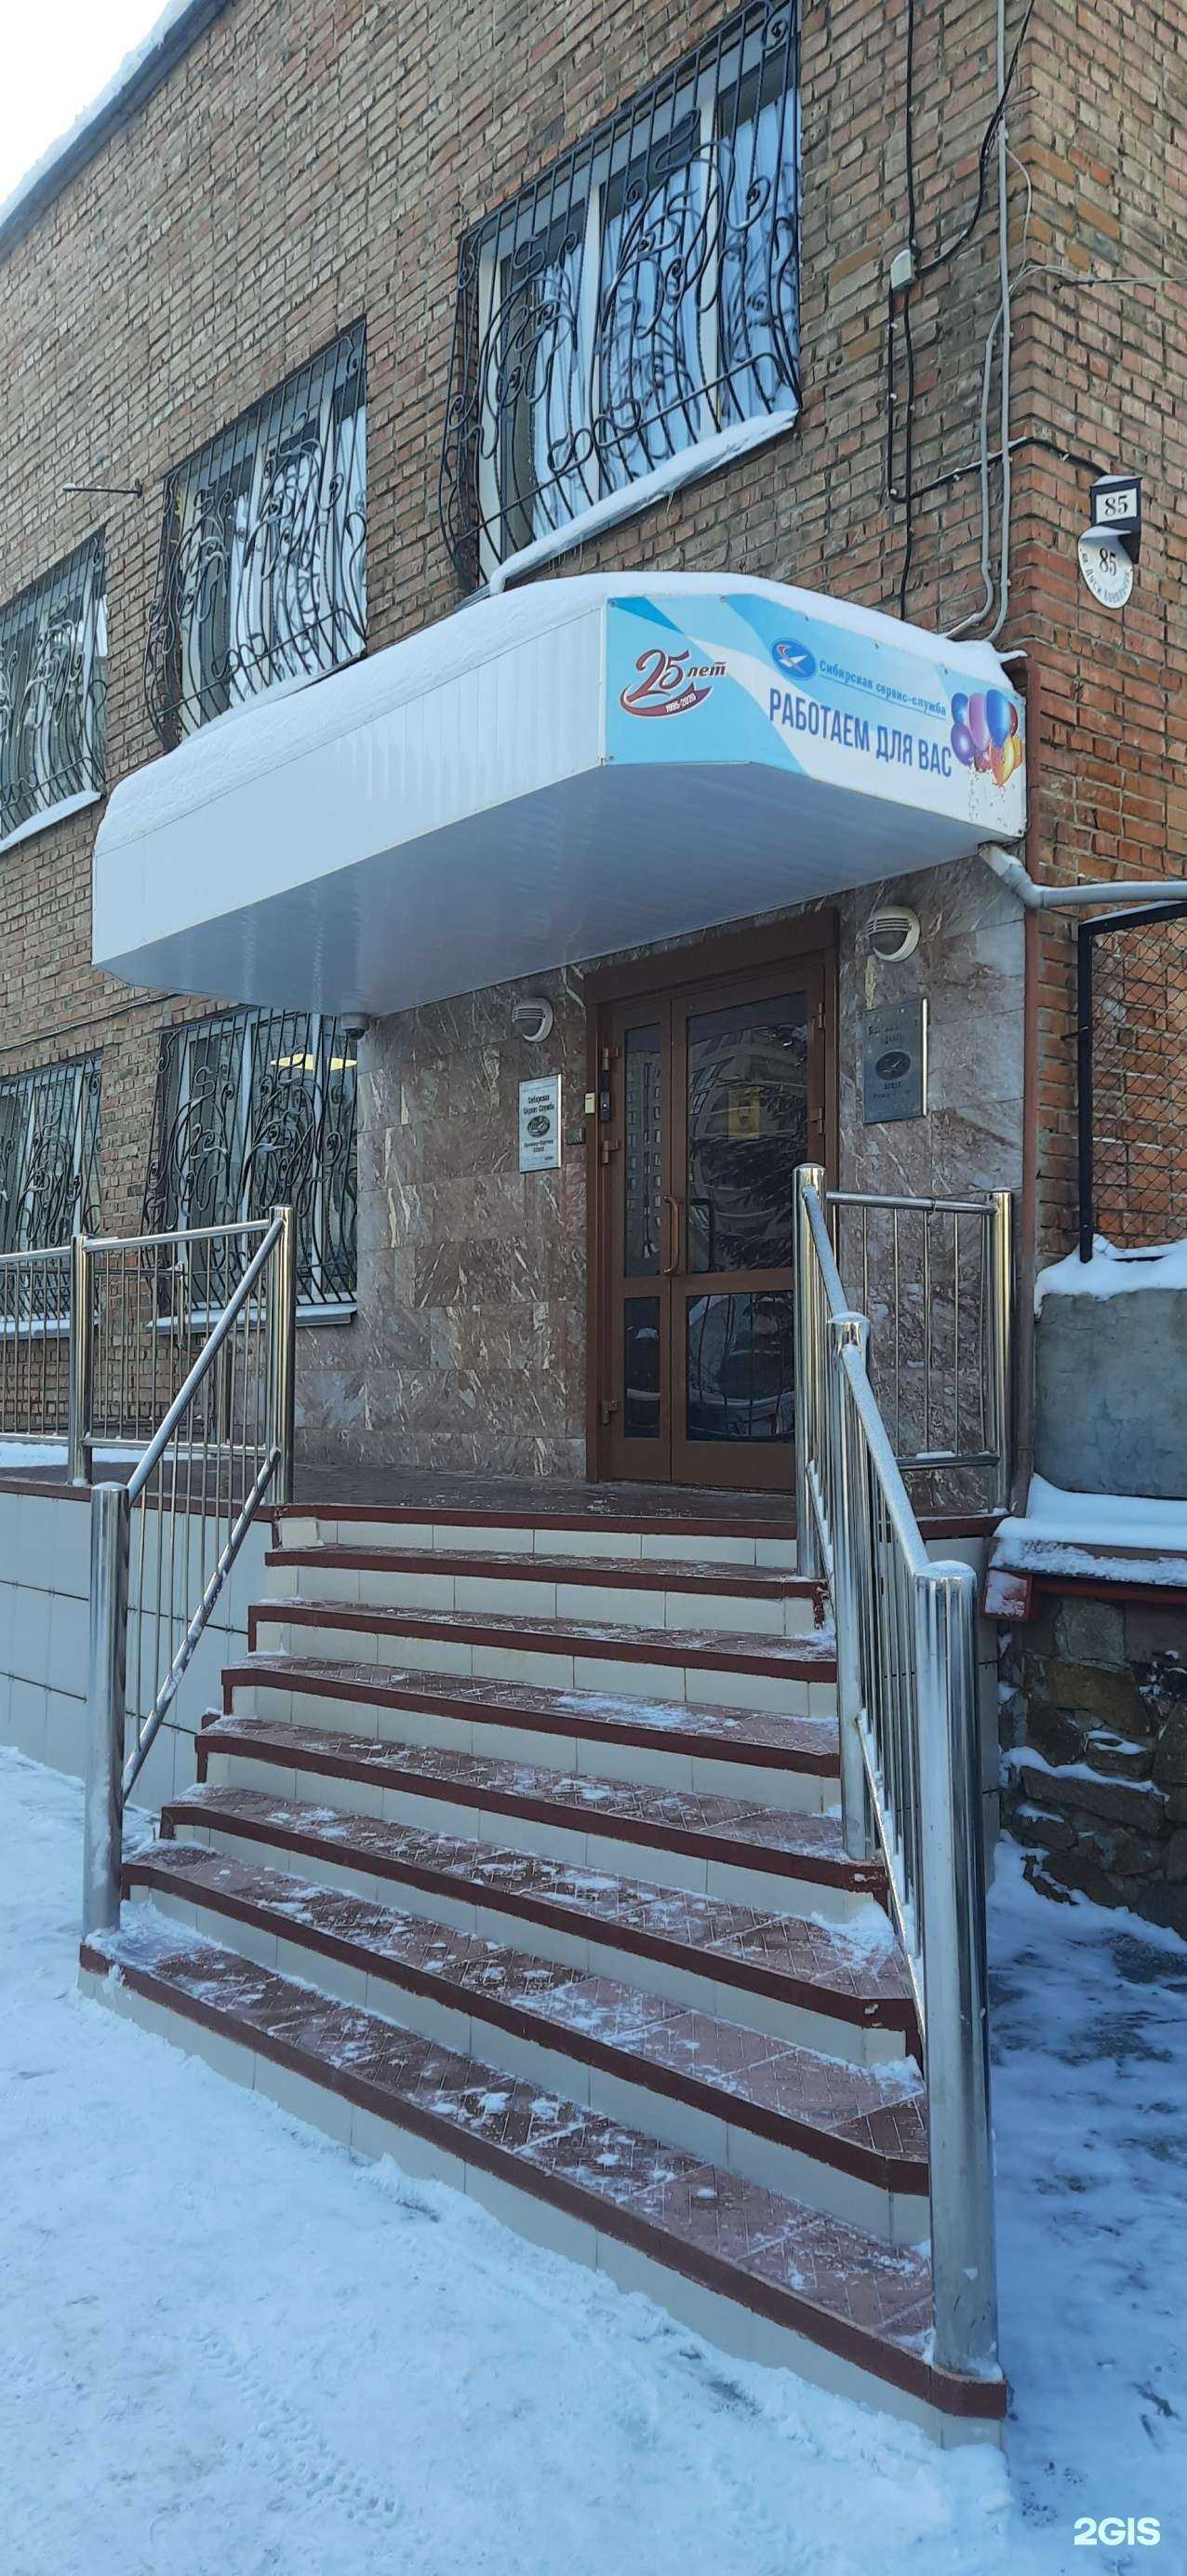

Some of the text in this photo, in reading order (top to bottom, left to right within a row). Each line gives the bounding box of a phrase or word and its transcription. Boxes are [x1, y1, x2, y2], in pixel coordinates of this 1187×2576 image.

[1104, 495, 1128, 517] 85
[1099, 547, 1117, 577] 85
[627, 649, 727, 702] 25 лет
[820, 660, 947, 717] Сибирская сервис-служба
[769, 688, 953, 778] РАБОТАЕМ ДЛЯ ВАС
